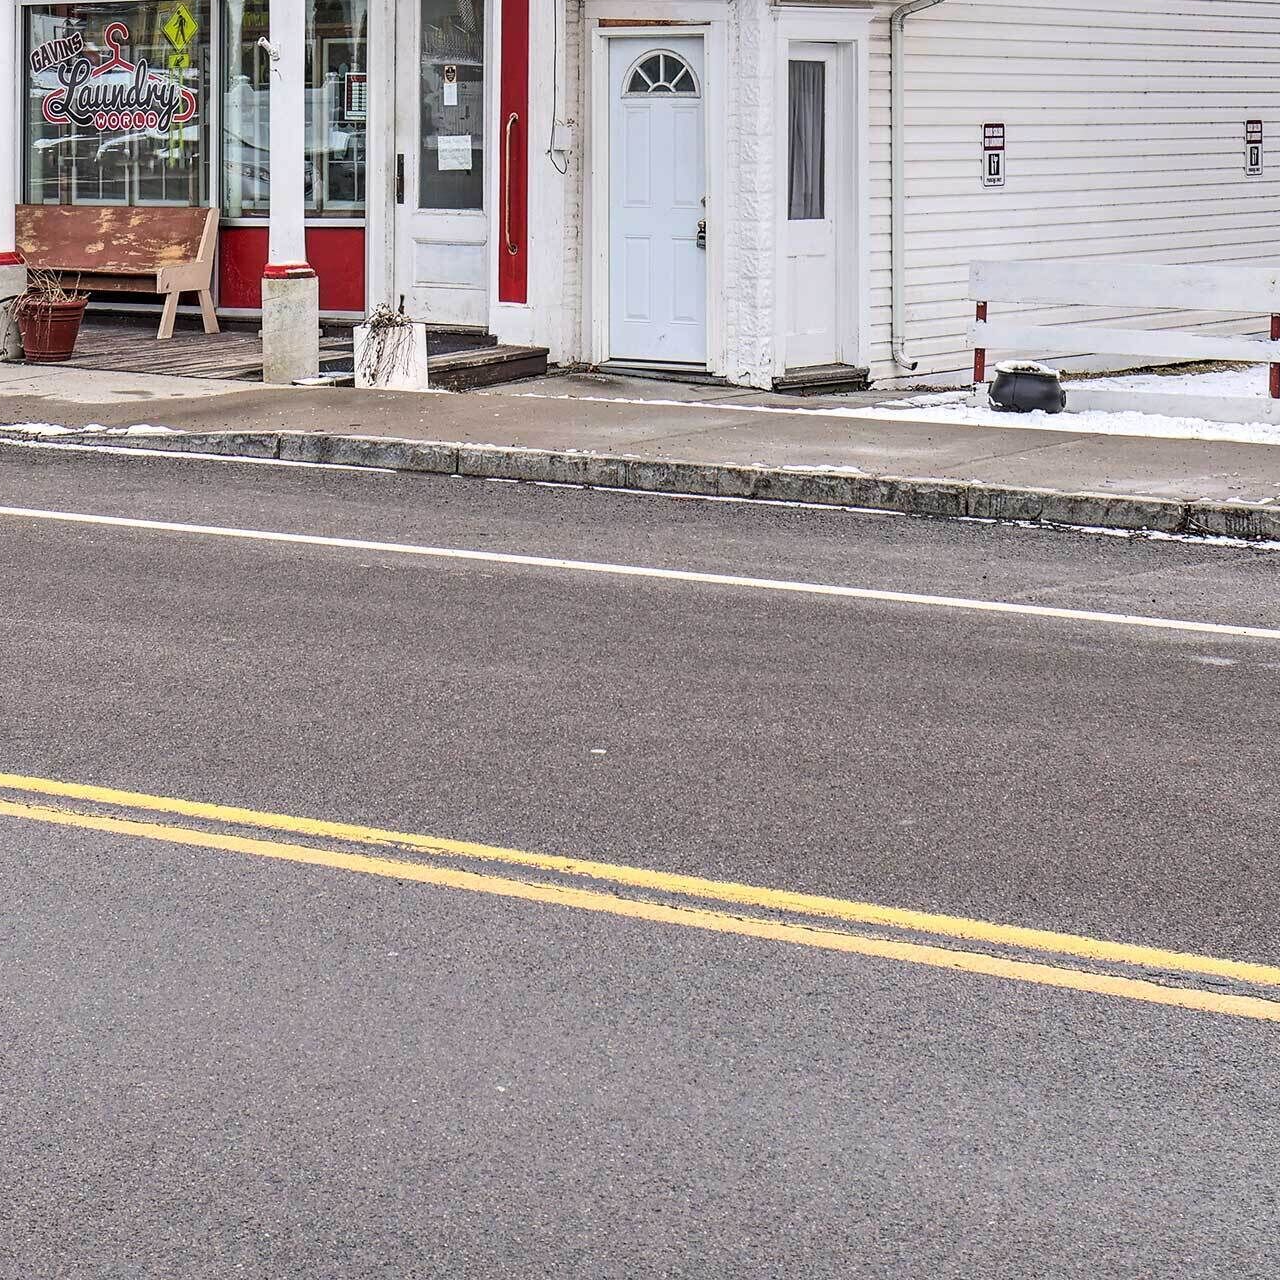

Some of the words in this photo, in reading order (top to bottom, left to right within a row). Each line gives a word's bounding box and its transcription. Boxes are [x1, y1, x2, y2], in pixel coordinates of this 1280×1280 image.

[30, 32, 84, 74] GAVINS
[48, 58, 180, 134] Laundry
[94, 110, 160, 131] WORLD
